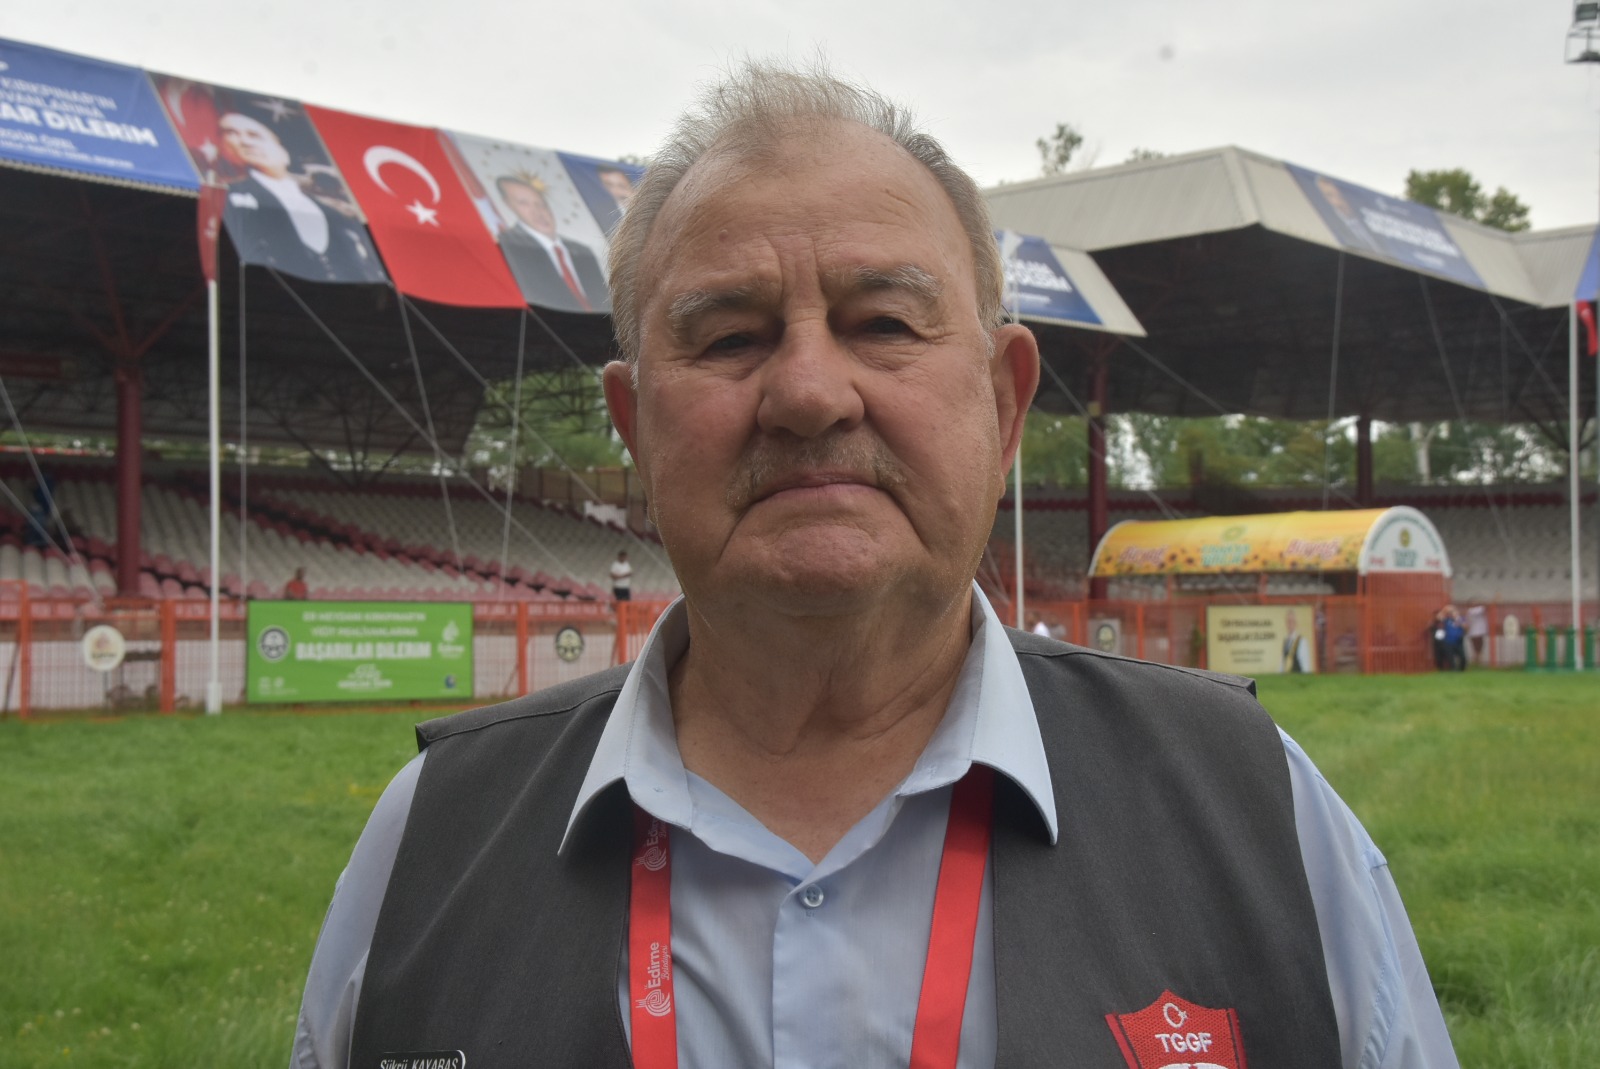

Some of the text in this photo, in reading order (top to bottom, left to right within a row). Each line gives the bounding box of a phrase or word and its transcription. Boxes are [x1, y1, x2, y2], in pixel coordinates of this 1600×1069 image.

[42, 110, 159, 147] DİLERİM
[295, 641, 432, 662] BAŞARILAR DİLERİM
[647, 941, 661, 989] Edirne
[1155, 1032, 1213, 1053] TGGF
